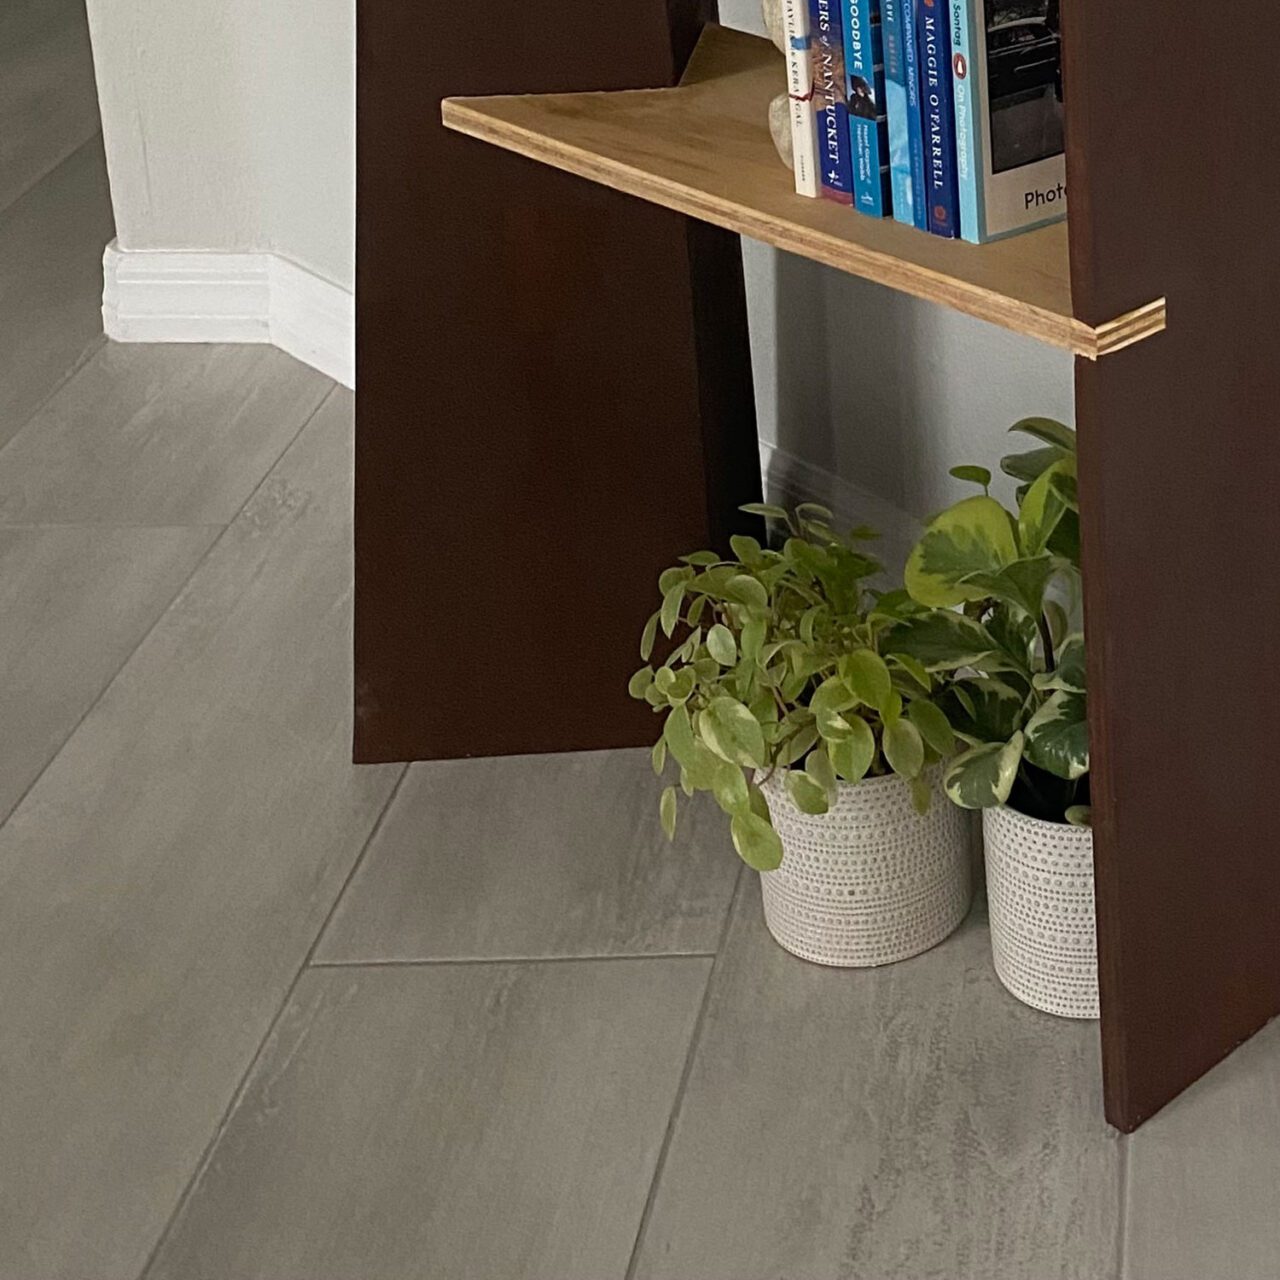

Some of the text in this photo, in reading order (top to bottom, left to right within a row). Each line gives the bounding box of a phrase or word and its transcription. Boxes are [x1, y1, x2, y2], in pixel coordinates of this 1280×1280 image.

[953, 4, 961, 47] Sontag
[791, 61, 803, 127] KERAGAL
[822, 53, 840, 164] NANTUCKET
[925, 17, 944, 190] MAGGIE O'FARRELL
[957, 84, 966, 101] On
